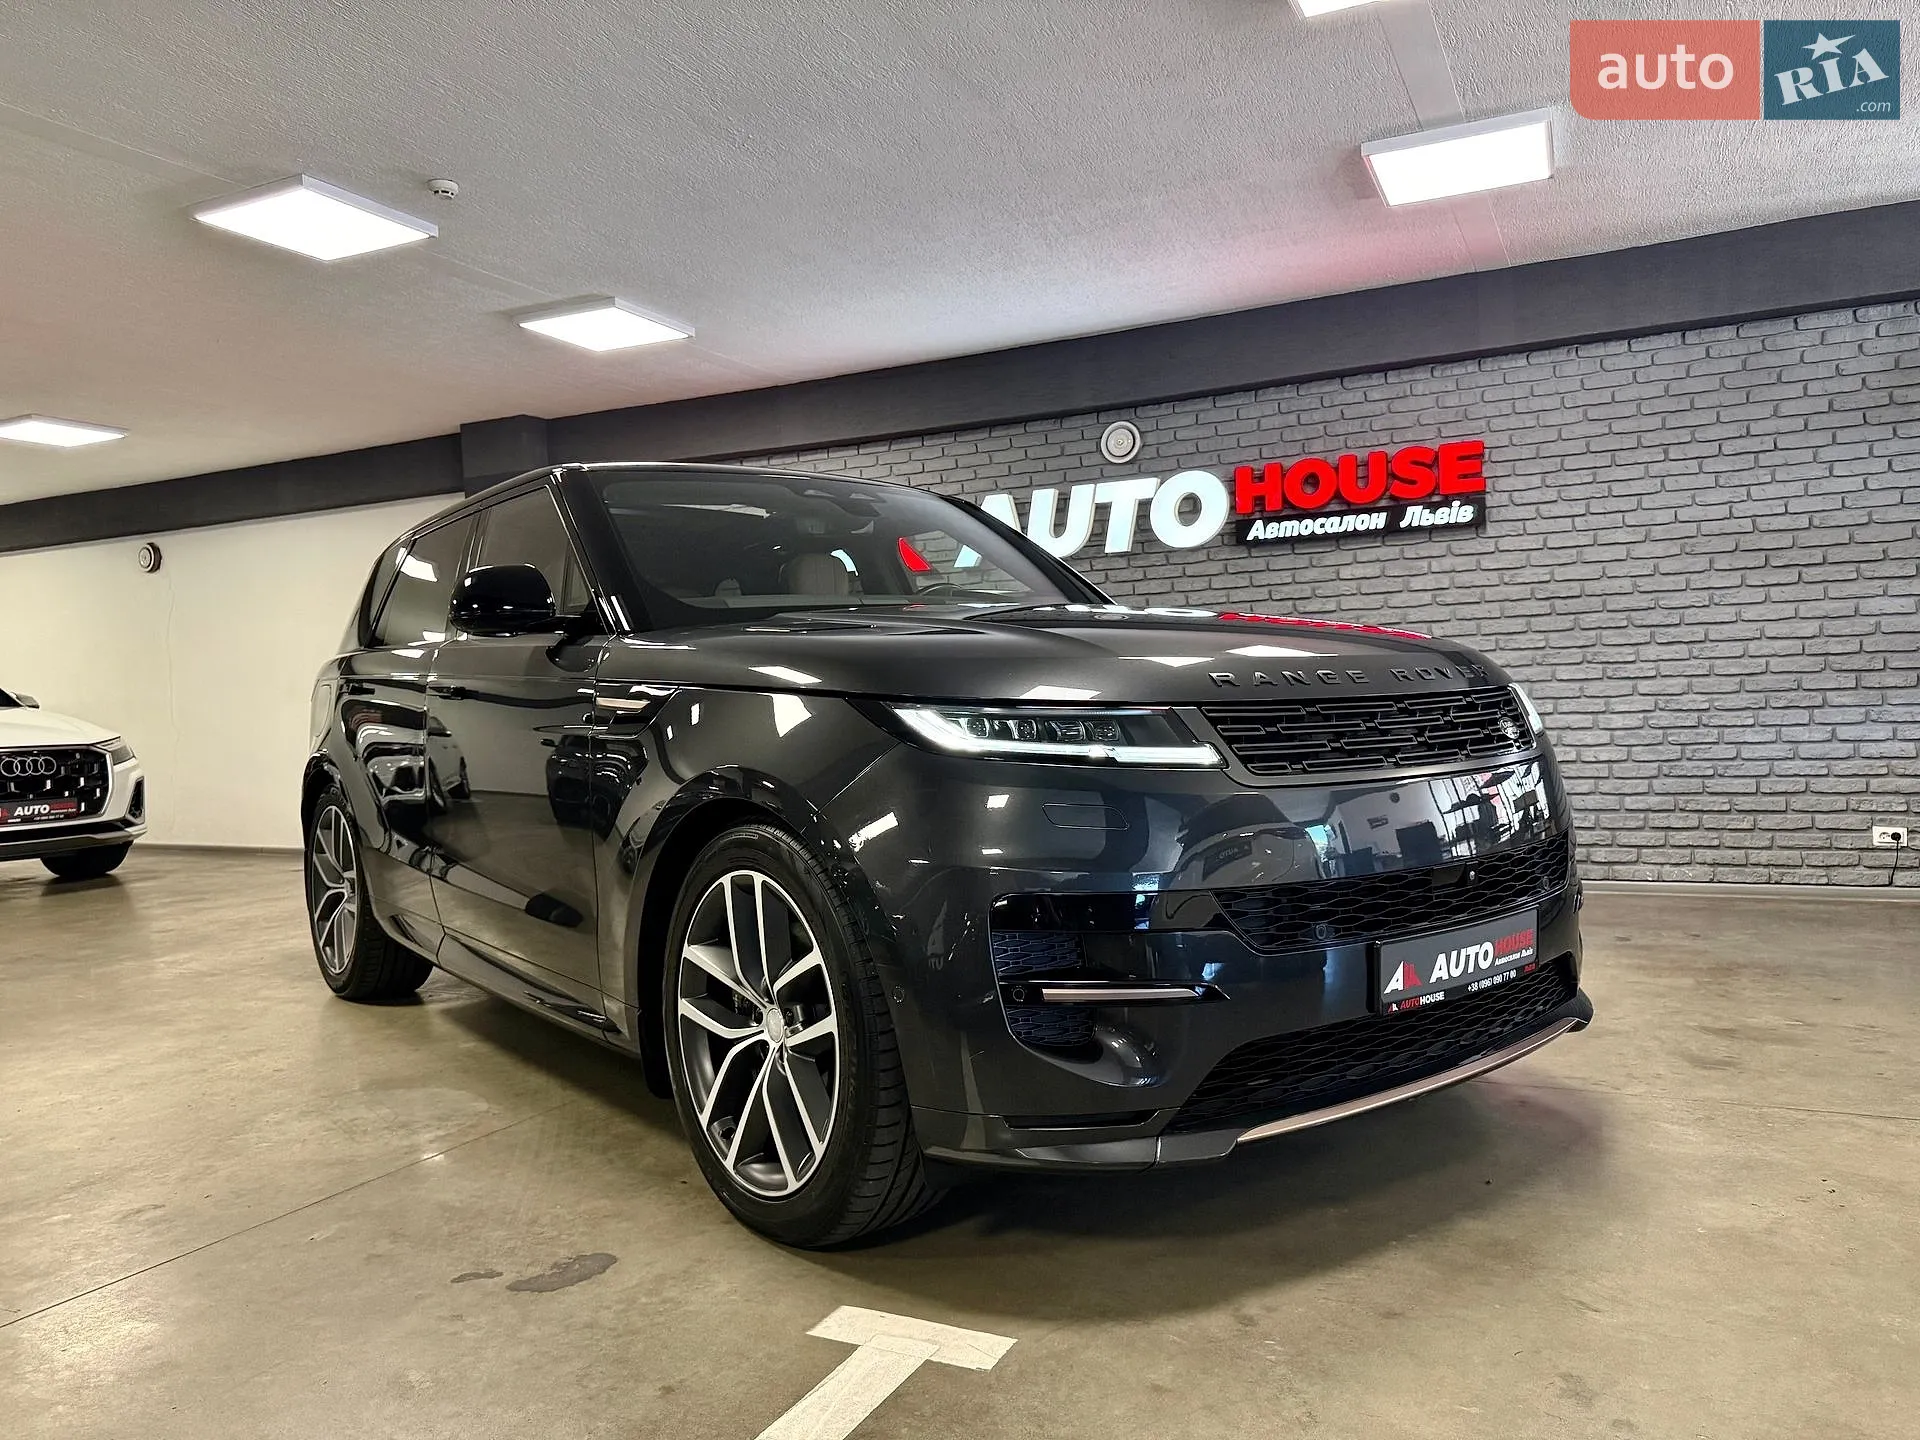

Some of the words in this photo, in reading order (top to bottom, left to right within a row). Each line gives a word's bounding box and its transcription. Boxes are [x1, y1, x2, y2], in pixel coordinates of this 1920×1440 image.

[1234, 440, 1487, 515] HOUSE
[1246, 511, 1388, 541] Автосалон
[1400, 500, 1475, 529] Львів
[1208, 669, 1371, 689] RANGE
[1388, 663, 1490, 682] ROVER
[14, 804, 50, 817] AUTO
[1429, 941, 1494, 984] AUTO
